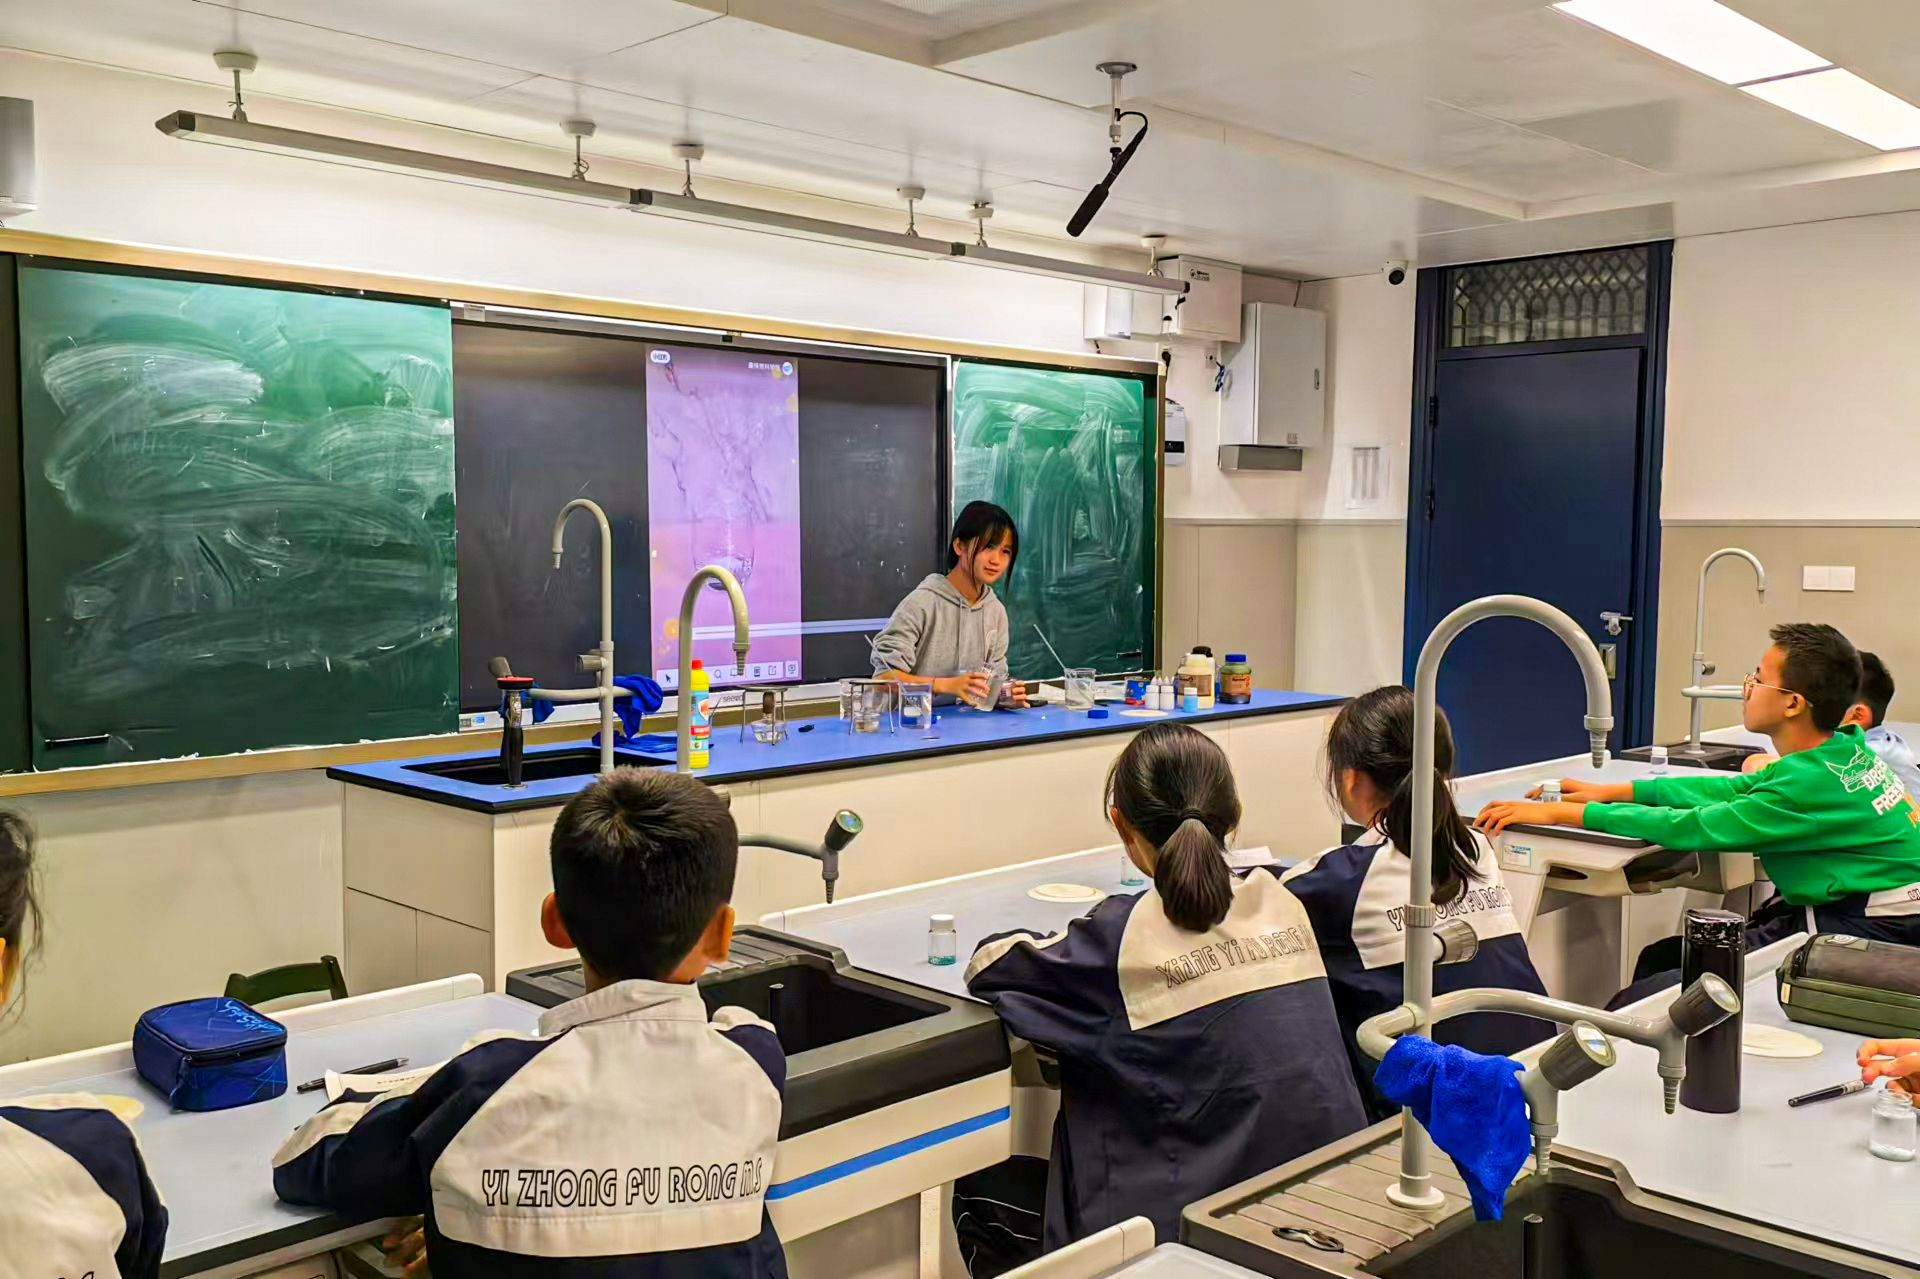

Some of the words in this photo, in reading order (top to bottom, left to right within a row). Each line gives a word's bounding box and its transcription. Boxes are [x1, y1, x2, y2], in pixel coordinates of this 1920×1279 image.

[482, 1169, 510, 1207] YI
[516, 1168, 617, 1208] ZHONG
[625, 1166, 661, 1206] FU
[668, 1162, 738, 1203] RONG
